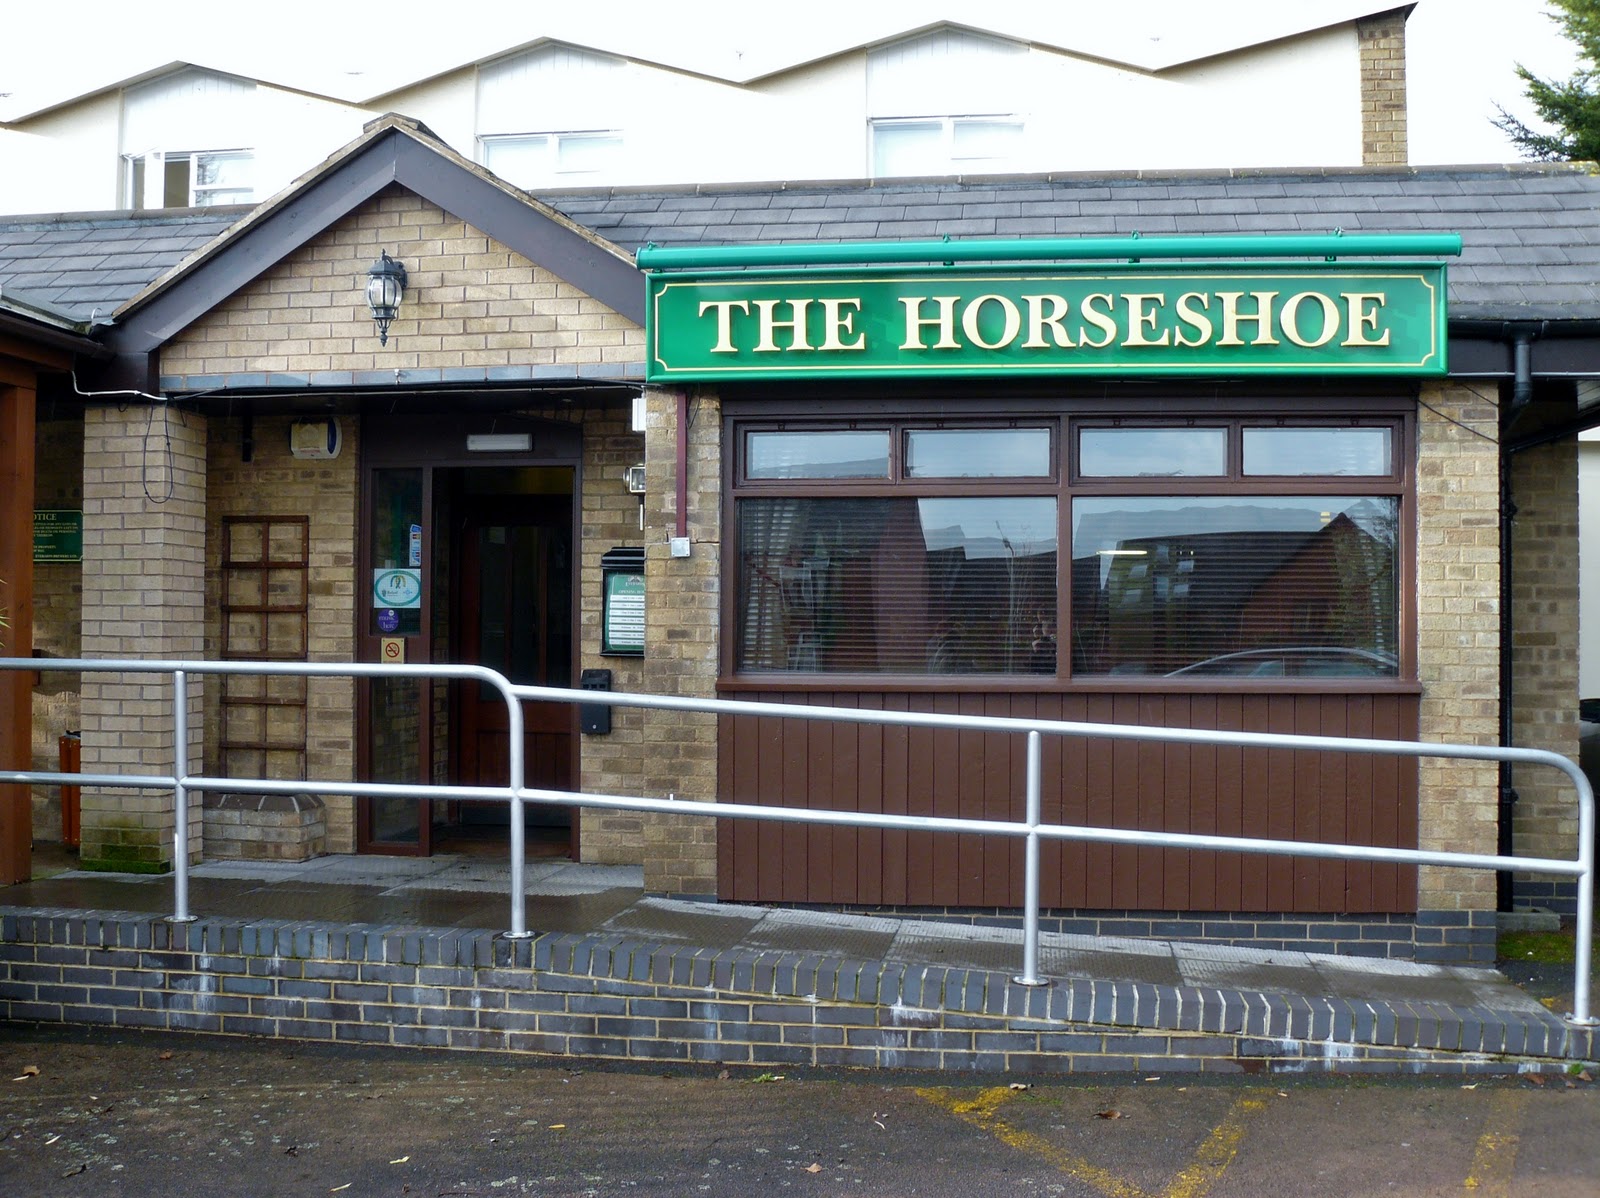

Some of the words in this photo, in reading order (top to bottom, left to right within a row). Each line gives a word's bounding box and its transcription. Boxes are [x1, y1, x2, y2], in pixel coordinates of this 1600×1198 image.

[699, 299, 865, 353] THE
[897, 291, 1390, 350] HORSESHOE
[33, 513, 57, 521] OTICE
